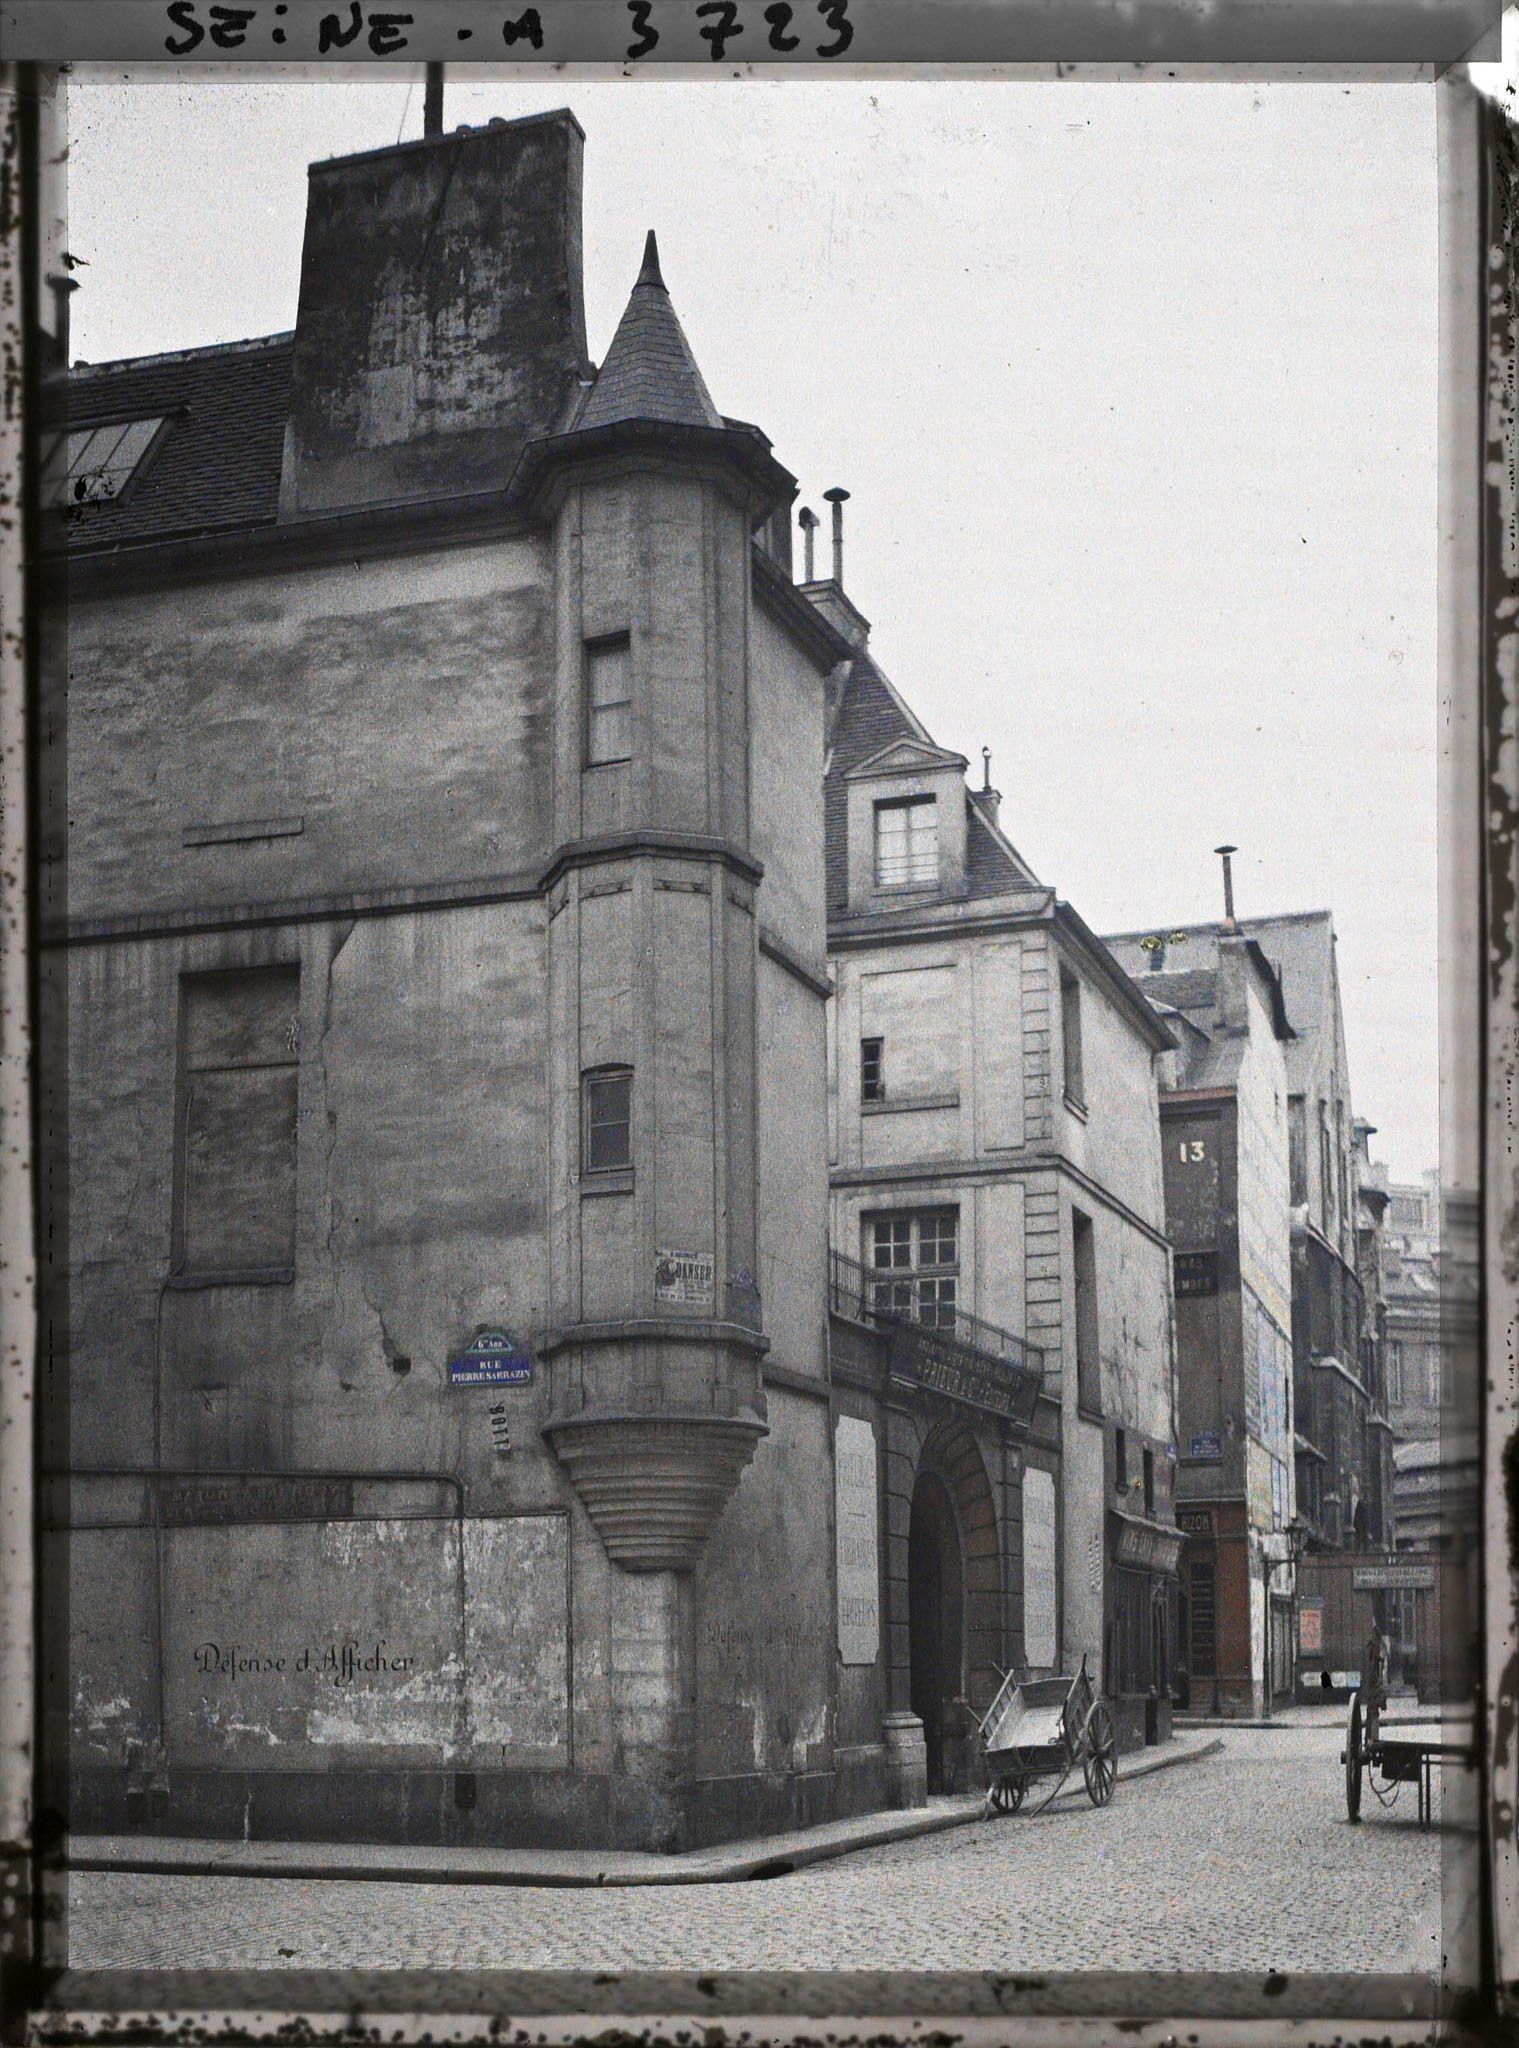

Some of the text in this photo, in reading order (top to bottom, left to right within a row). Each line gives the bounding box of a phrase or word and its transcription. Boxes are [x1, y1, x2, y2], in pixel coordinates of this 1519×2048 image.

[626, 1, 855, 58] 3723
[1178, 1140, 1206, 1163] 13
[479, 1360, 501, 1369] RUE
[452, 1369, 530, 1382] PIERRE SARRAZIN
